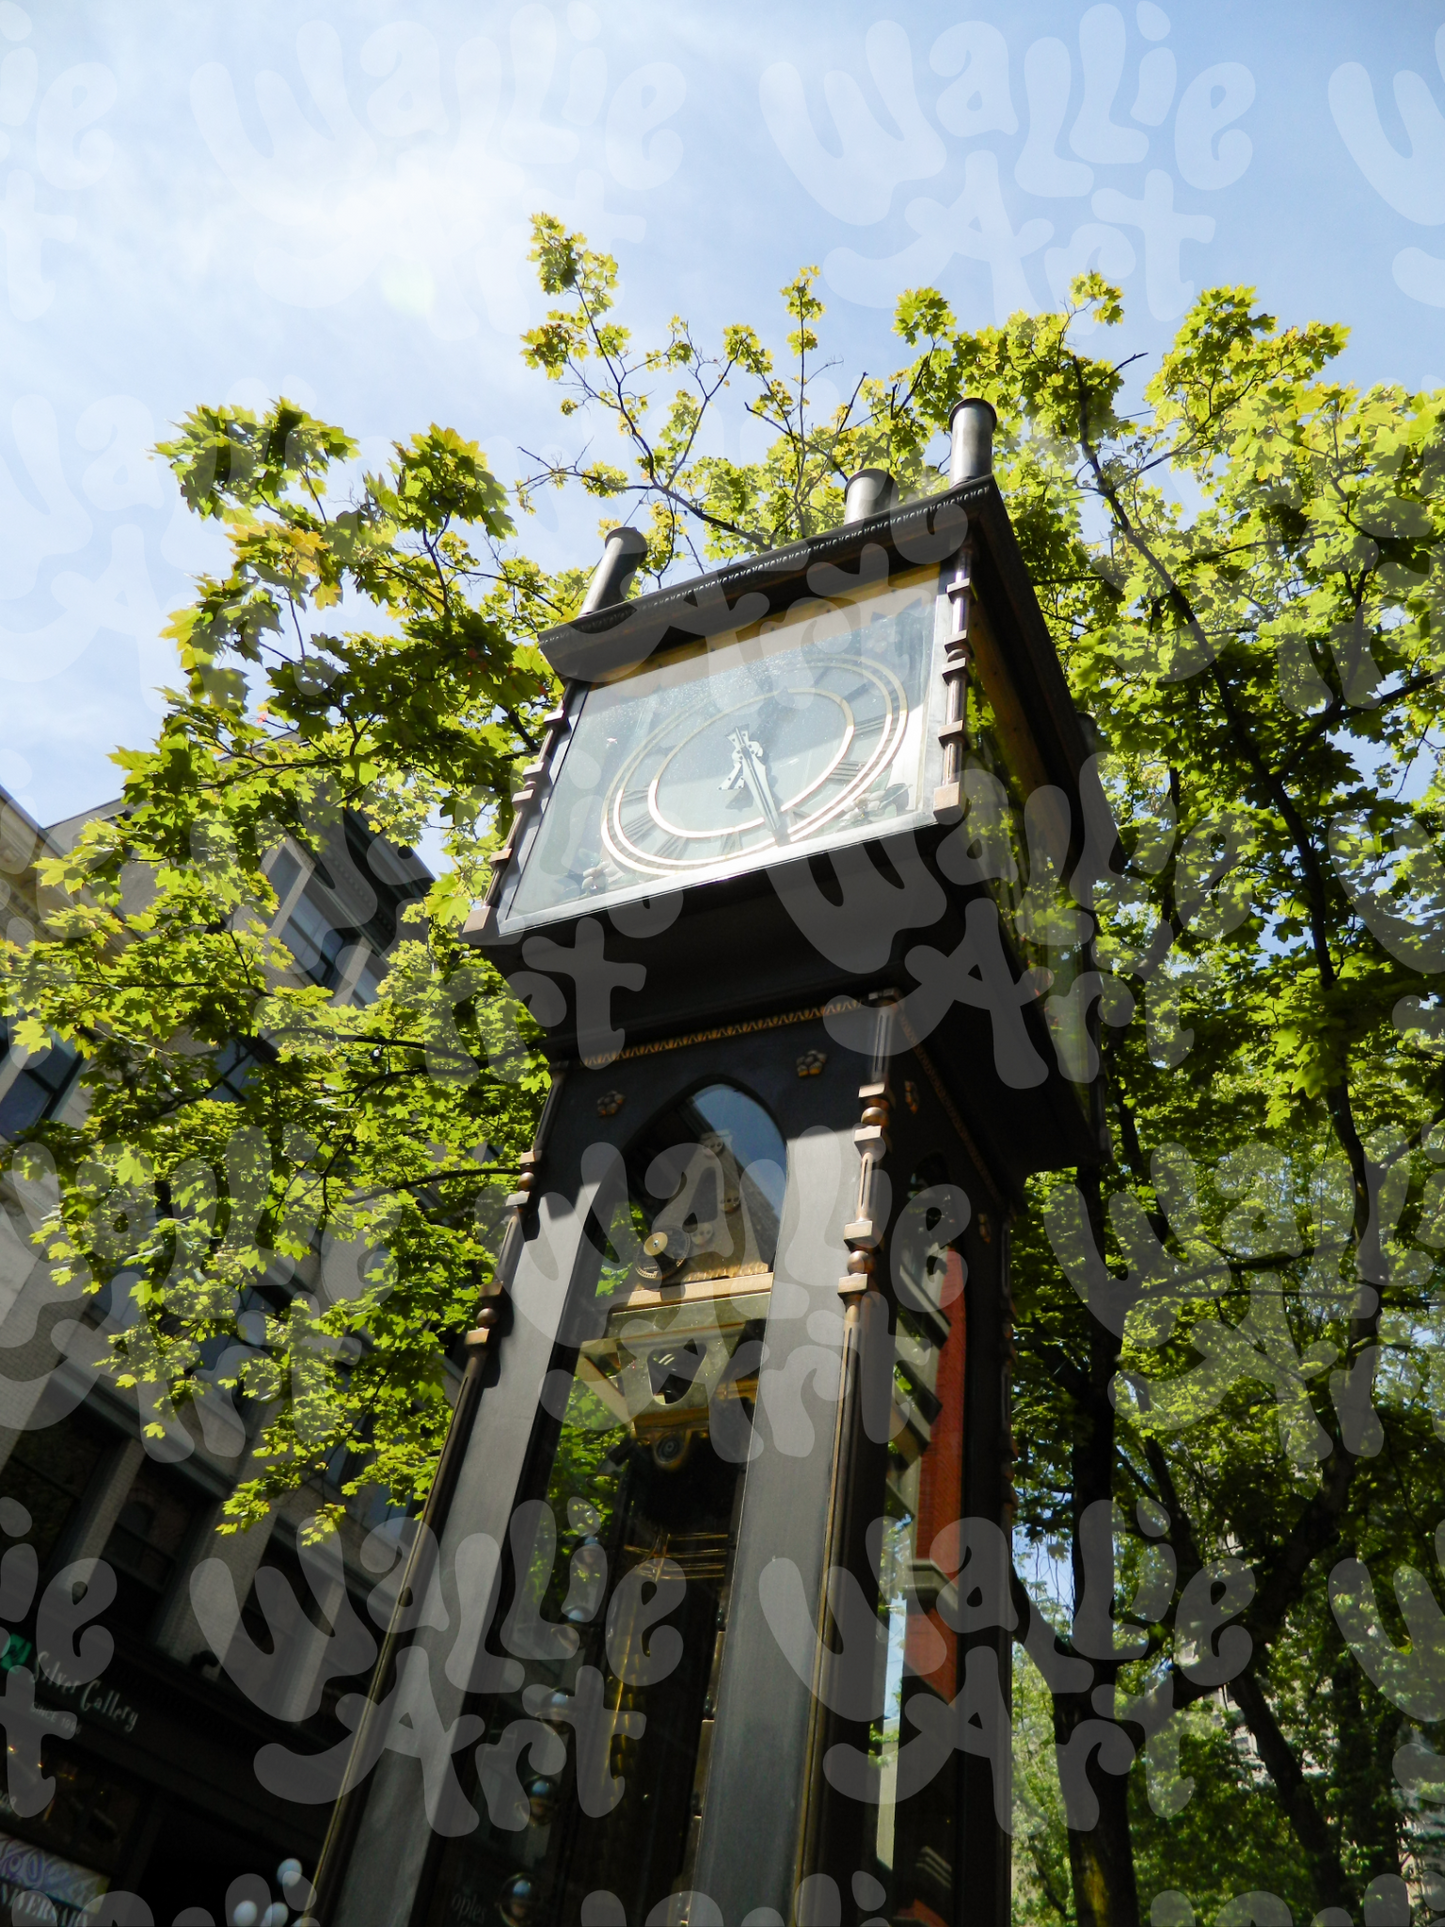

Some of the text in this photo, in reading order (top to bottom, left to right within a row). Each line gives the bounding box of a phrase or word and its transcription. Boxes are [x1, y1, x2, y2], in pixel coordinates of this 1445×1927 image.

[29, 1701, 60, 1723] SINCE
[31, 1652, 139, 1732] Silver Gallery
